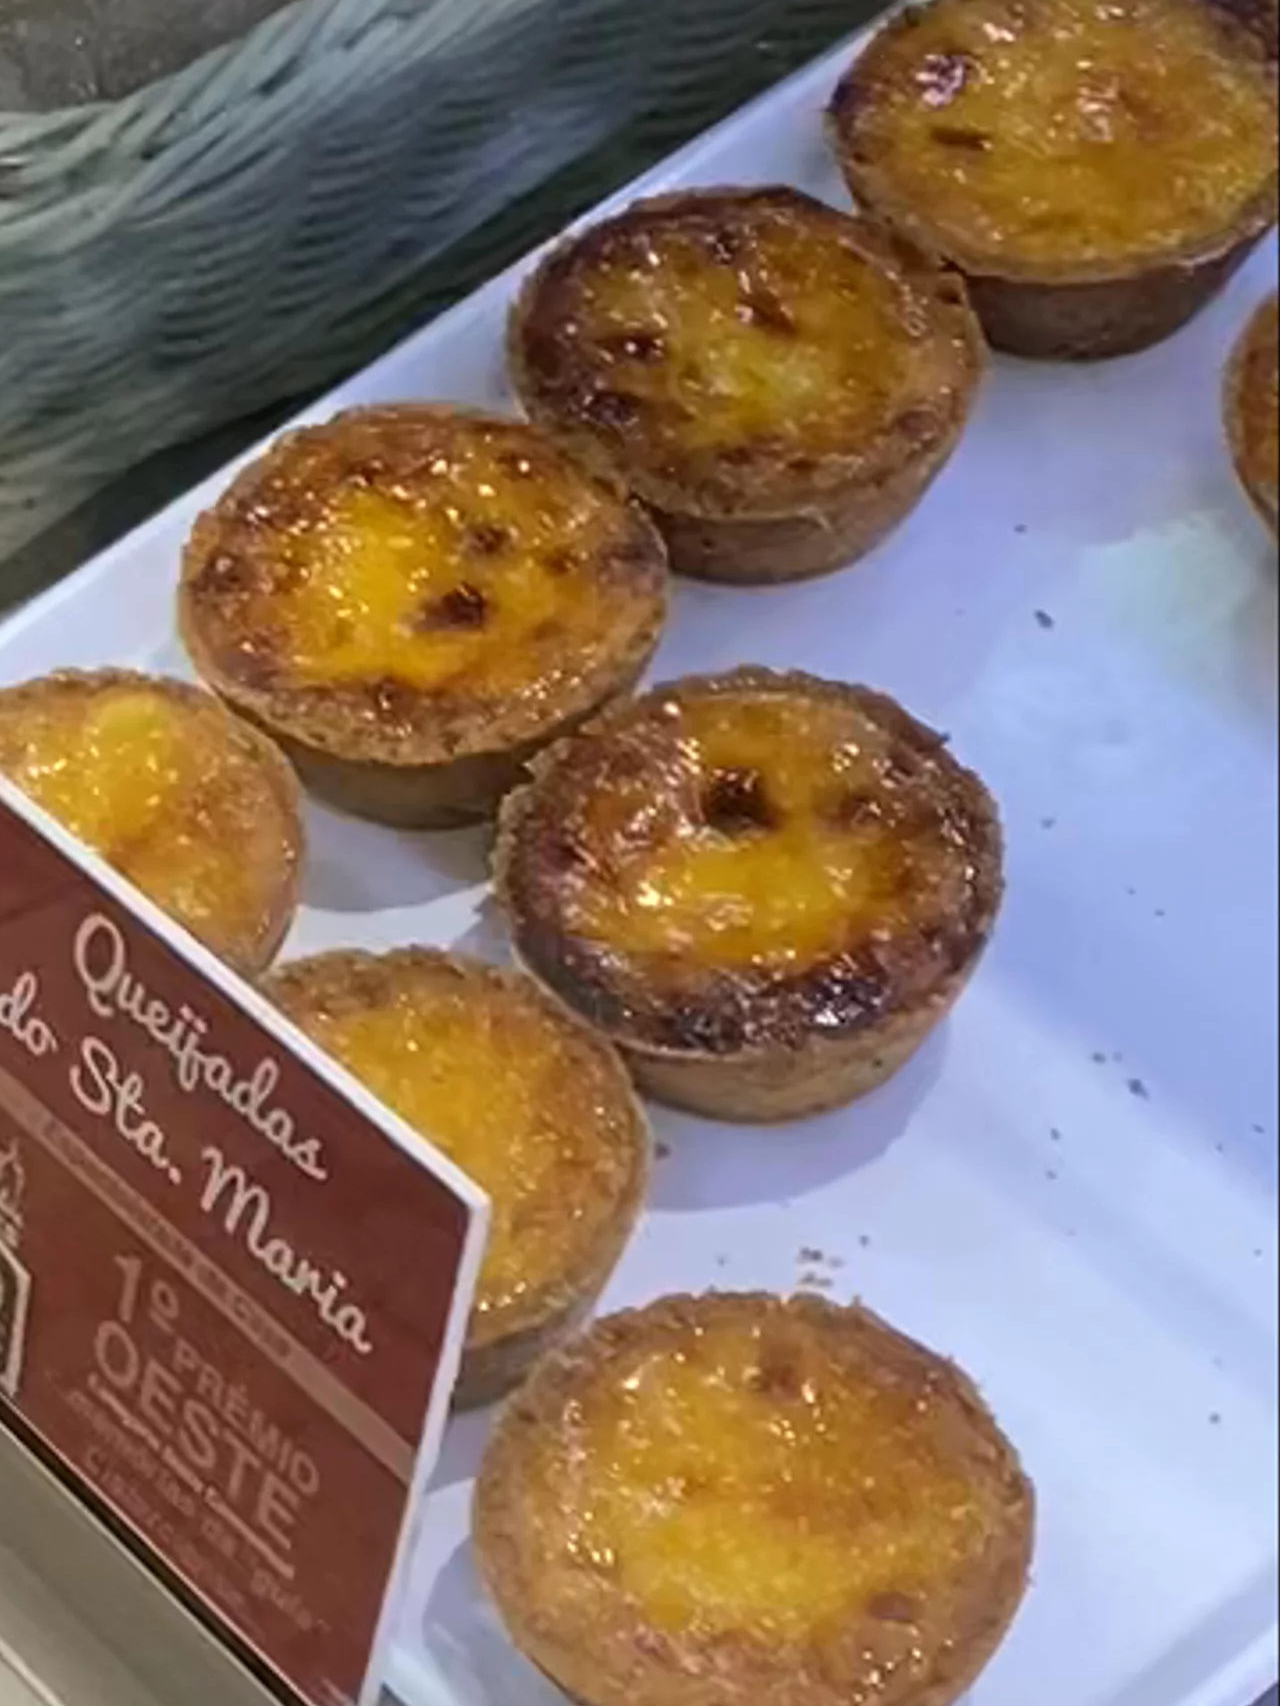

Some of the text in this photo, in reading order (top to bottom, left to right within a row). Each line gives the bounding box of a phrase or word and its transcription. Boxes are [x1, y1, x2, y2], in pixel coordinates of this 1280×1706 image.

[74, 912, 328, 1180] Queijadas
[69, 1035, 182, 1186] Sta.
[200, 1146, 373, 1355] Maria
[93, 1318, 301, 1552] OESTE
